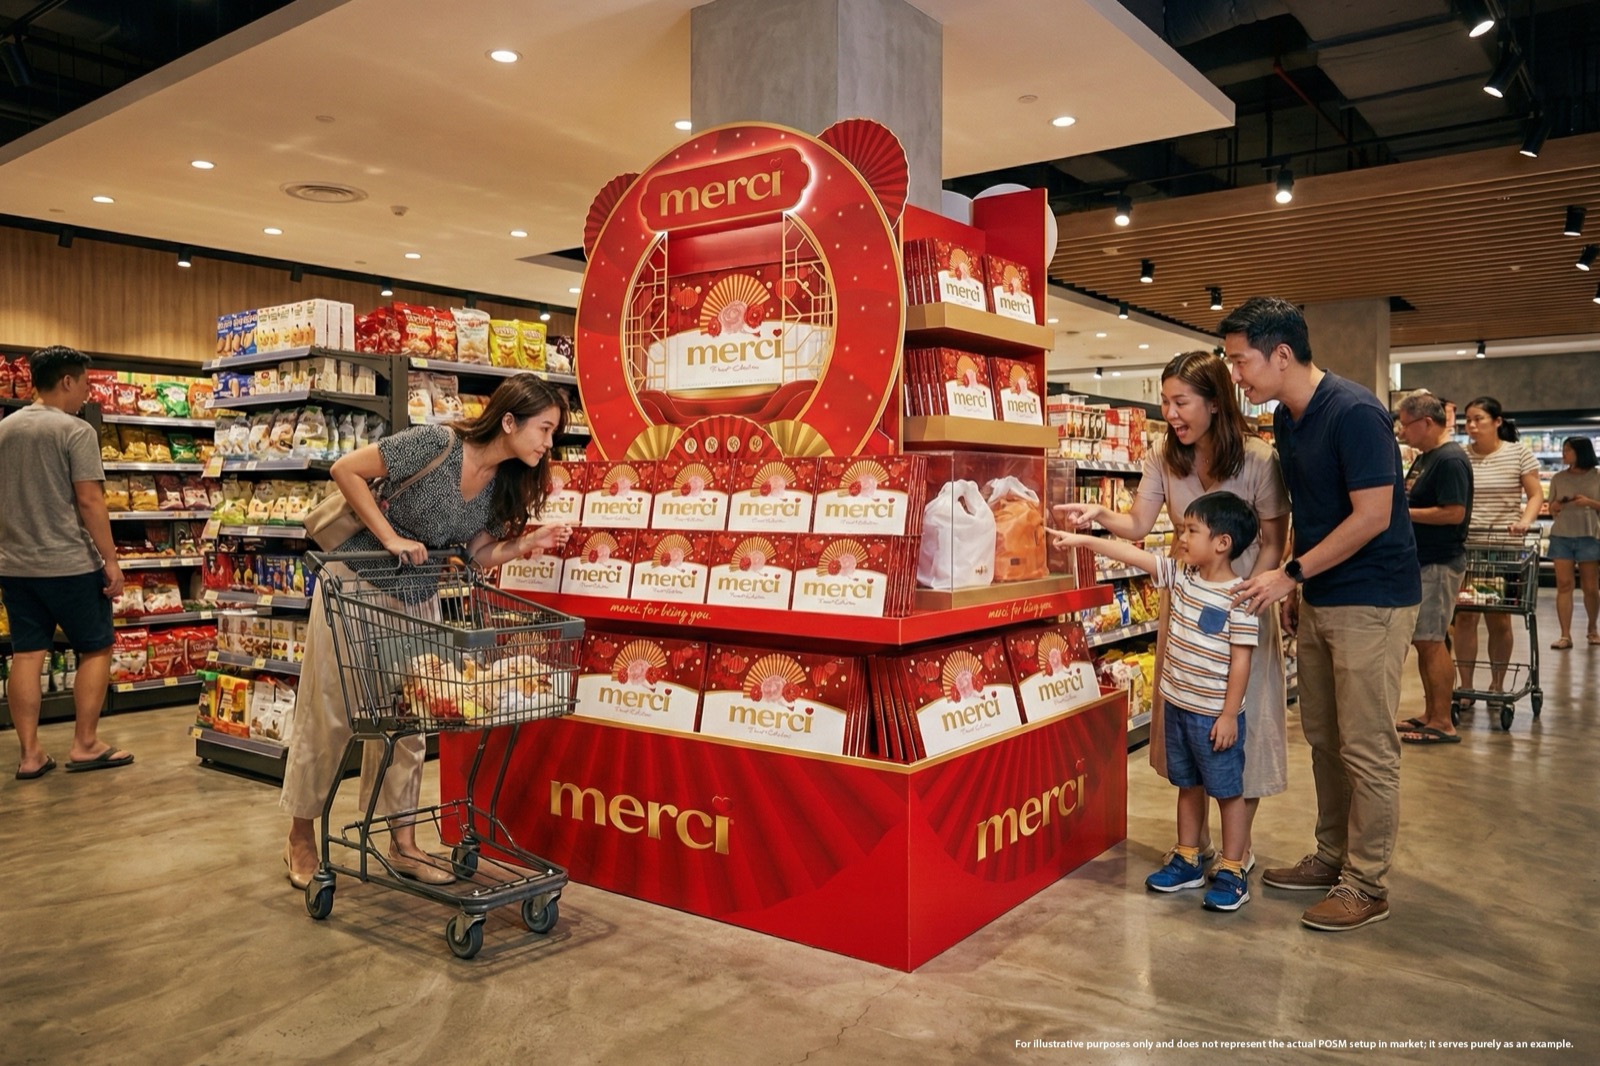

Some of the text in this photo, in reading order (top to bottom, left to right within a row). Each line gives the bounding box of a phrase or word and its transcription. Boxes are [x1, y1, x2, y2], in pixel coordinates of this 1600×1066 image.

[659, 157, 784, 217] merci
[946, 282, 981, 303] merci
[1000, 296, 1031, 315] merci
[687, 328, 782, 366] merci
[953, 390, 987, 408] merci
[1007, 398, 1037, 414] merci
[539, 497, 575, 514] erci
[590, 497, 643, 515] merci
[661, 497, 718, 516] merci
[739, 498, 800, 517] merci
[825, 498, 895, 518] merci
[507, 562, 554, 579] merci
[570, 565, 622, 583] merci
[640, 570, 698, 588] merci
[718, 573, 781, 593] merci
[803, 578, 874, 599] merci
[642, 602, 660, 619] for
[660, 603, 688, 624] being
[688, 610, 711, 625] you.
[1010, 601, 1021, 621] for
[1038, 668, 1084, 702] merci
[598, 686, 672, 712] merci
[729, 703, 814, 733] merci
[941, 690, 1001, 732] merci
[549, 780, 732, 855] merci
[977, 758, 1087, 862] merci
